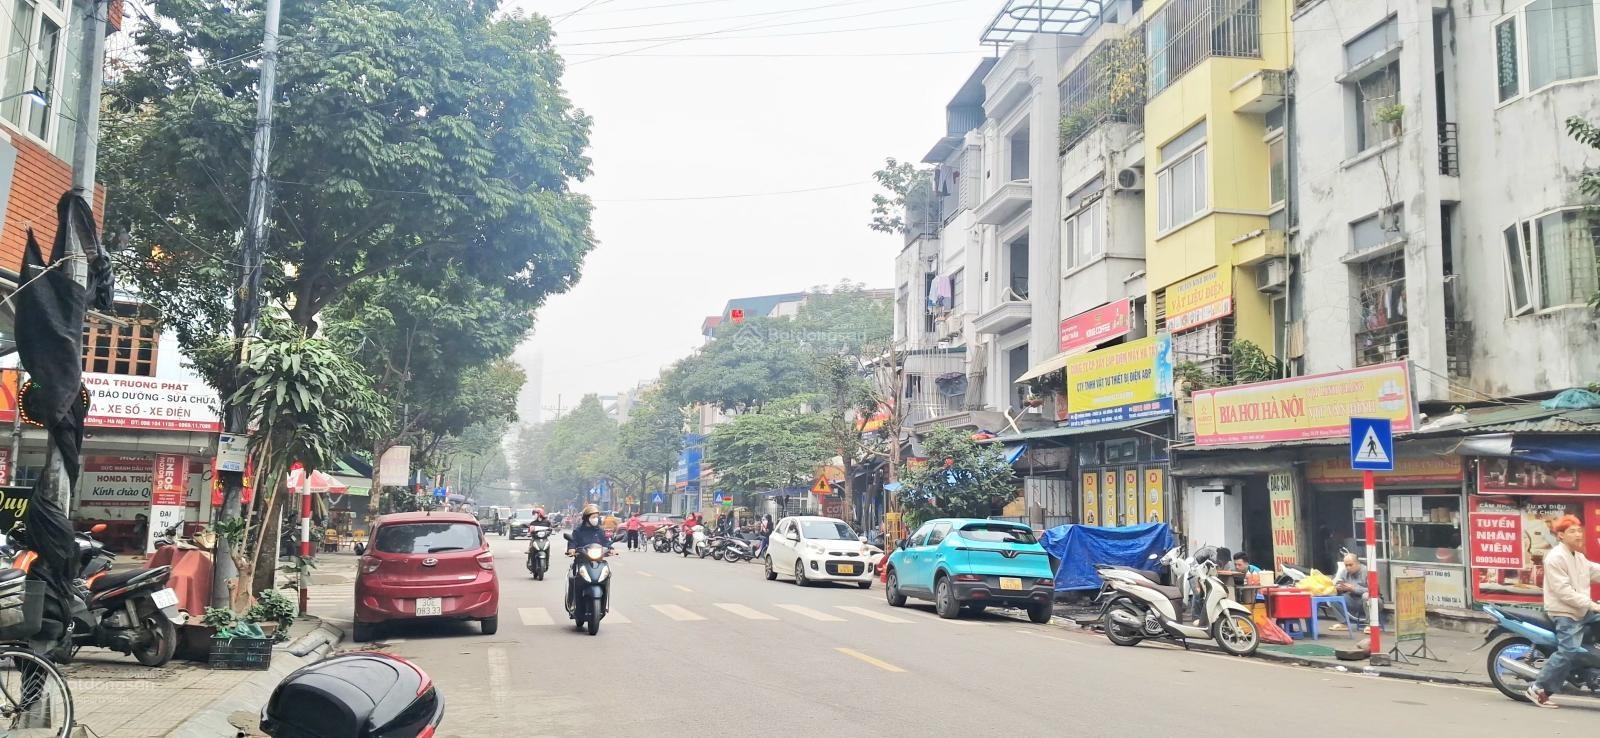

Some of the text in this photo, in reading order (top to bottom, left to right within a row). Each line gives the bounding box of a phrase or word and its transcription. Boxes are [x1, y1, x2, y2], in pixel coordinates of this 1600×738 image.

[107, 404, 122, 414] XE
[125, 402, 140, 415] SỐ
[149, 406, 163, 416] XE
[1219, 405, 1239, 424] BIA
[1262, 395, 1281, 420] HÀ
[1280, 393, 1305, 423] NỘI
[97, 475, 128, 483] HONDA
[164, 456, 175, 491] ENEOS
[92, 486, 115, 497] Kính
[117, 486, 139, 497] chào
[1273, 500, 1291, 520] VỊT
[1275, 526, 1294, 546] VÂN
[1476, 528, 1516, 541] NHÂN
[1480, 542, 1513, 553] VIÊN
